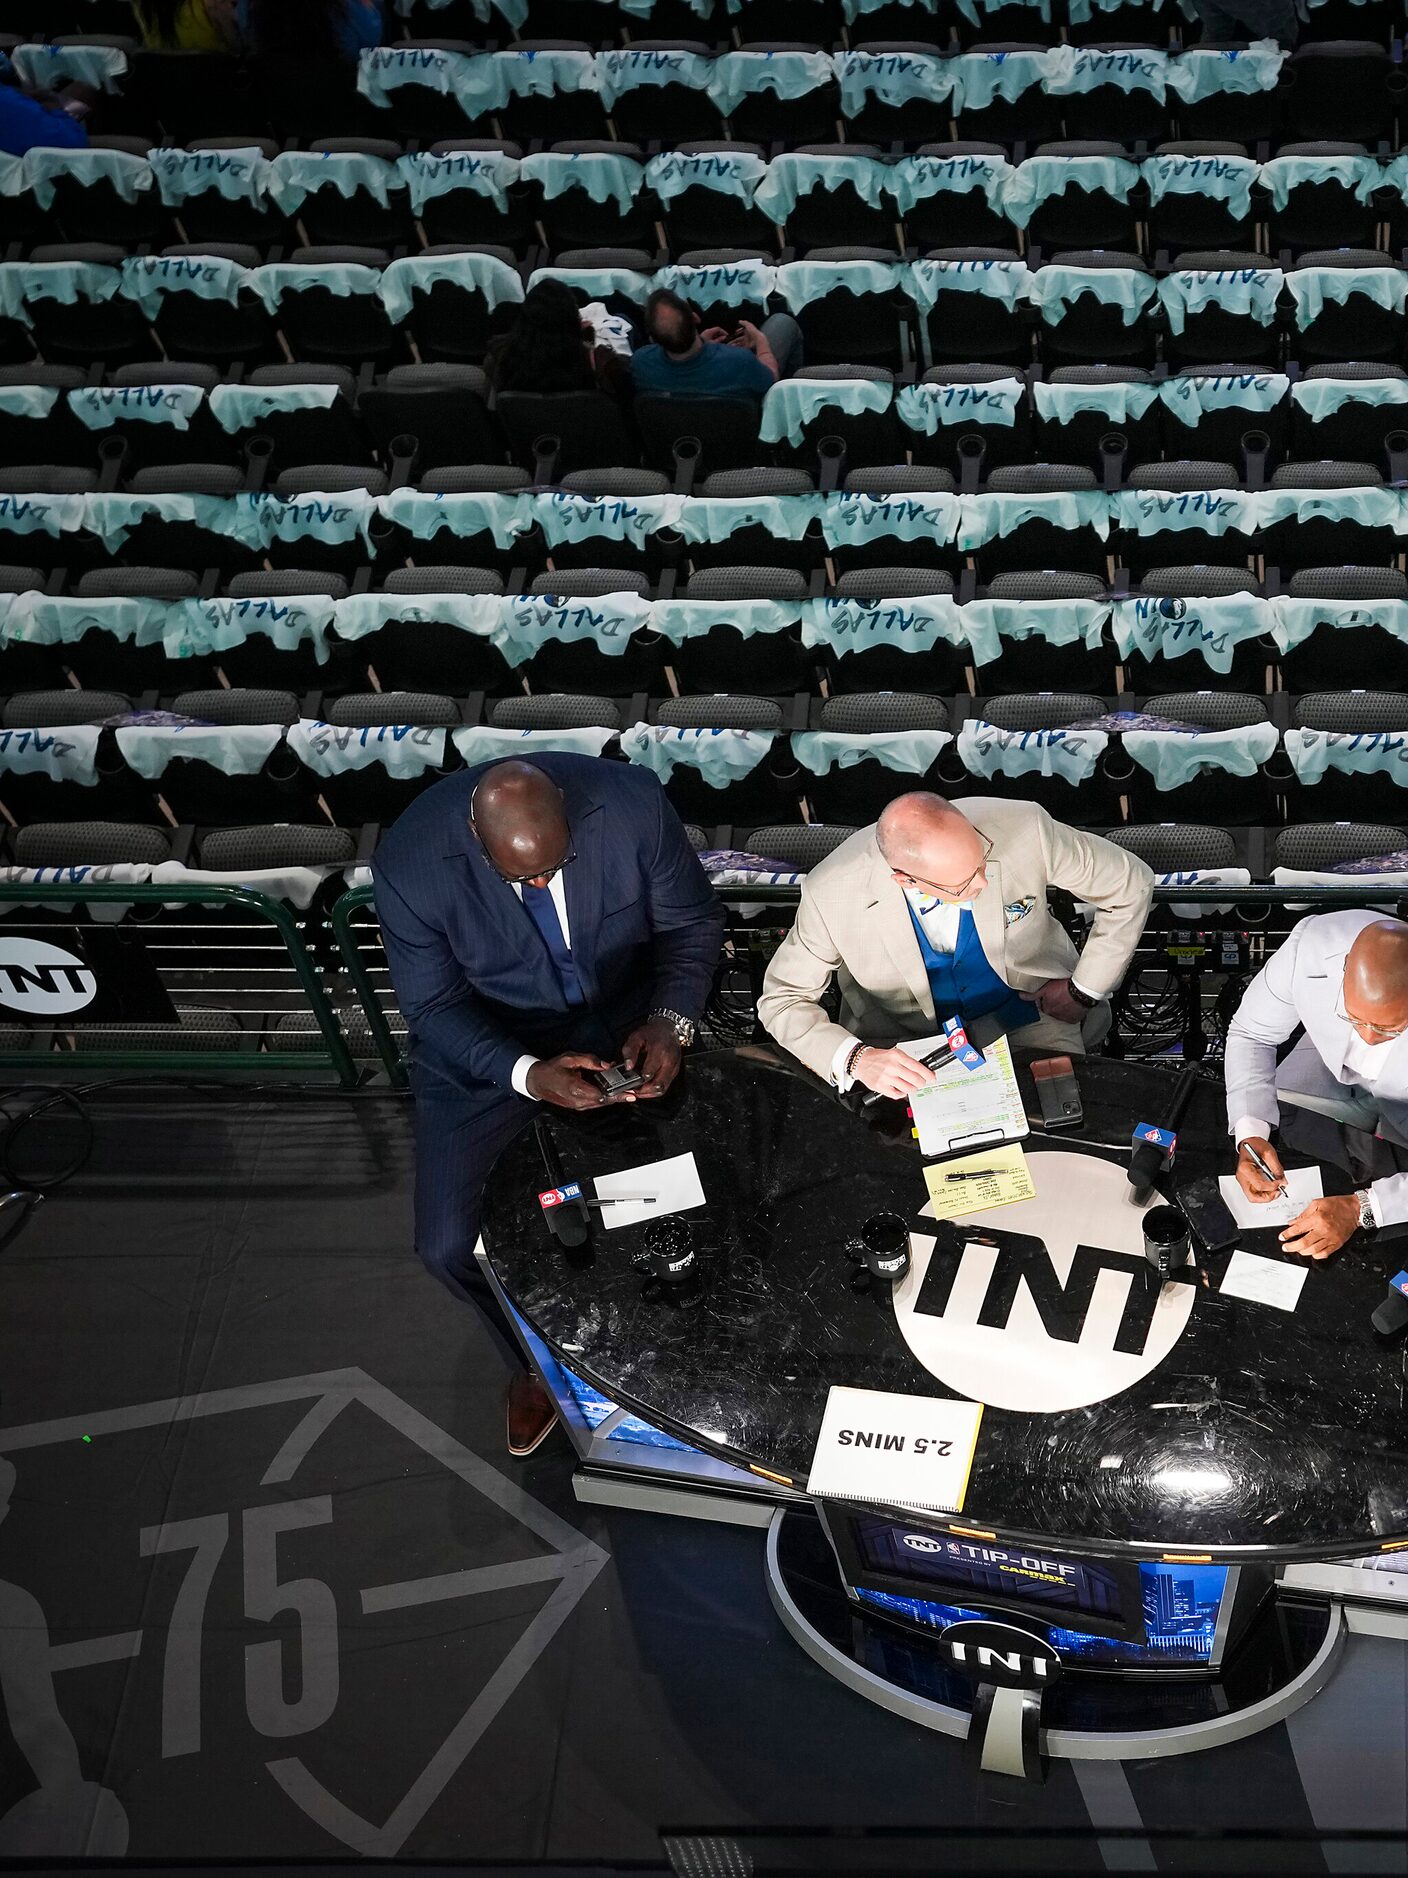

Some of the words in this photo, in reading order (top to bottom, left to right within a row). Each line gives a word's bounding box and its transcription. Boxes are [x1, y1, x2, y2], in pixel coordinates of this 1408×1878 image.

[370, 51, 447, 69] DALLAS
[607, 52, 684, 72] DALLAS
[846, 57, 927, 79] DALLAS
[1075, 55, 1159, 77] DALLAS
[165, 153, 246, 175] DALLAS
[663, 157, 741, 181] DALLAS
[918, 158, 994, 183] DALLAS
[1160, 158, 1243, 181] DALLAS
[86, 388, 181, 410] DALLAS
[919, 388, 1006, 412] DALLAS
[1177, 376, 1272, 400] DALLAS
[560, 501, 652, 529] DALLAS
[842, 500, 943, 526] DALLAS
[1140, 494, 1237, 518] DALLAS
[205, 599, 306, 628] DALLAS
[515, 607, 625, 636] DALLAS
[831, 606, 935, 633] DALLAS
[310, 726, 433, 755] DALLAS
[976, 730, 1087, 756] DALLAS
[0, 964, 94, 994] NT
[912, 1214, 1197, 1356] TNT
[838, 1429, 905, 1452] MINS
[914, 1438, 953, 1457] 2.5
[904, 1539, 941, 1551] TNT
[961, 1544, 1076, 1577] TIP-OFF
[139, 1495, 341, 1759] 75
[948, 1641, 1052, 1676] TNT
